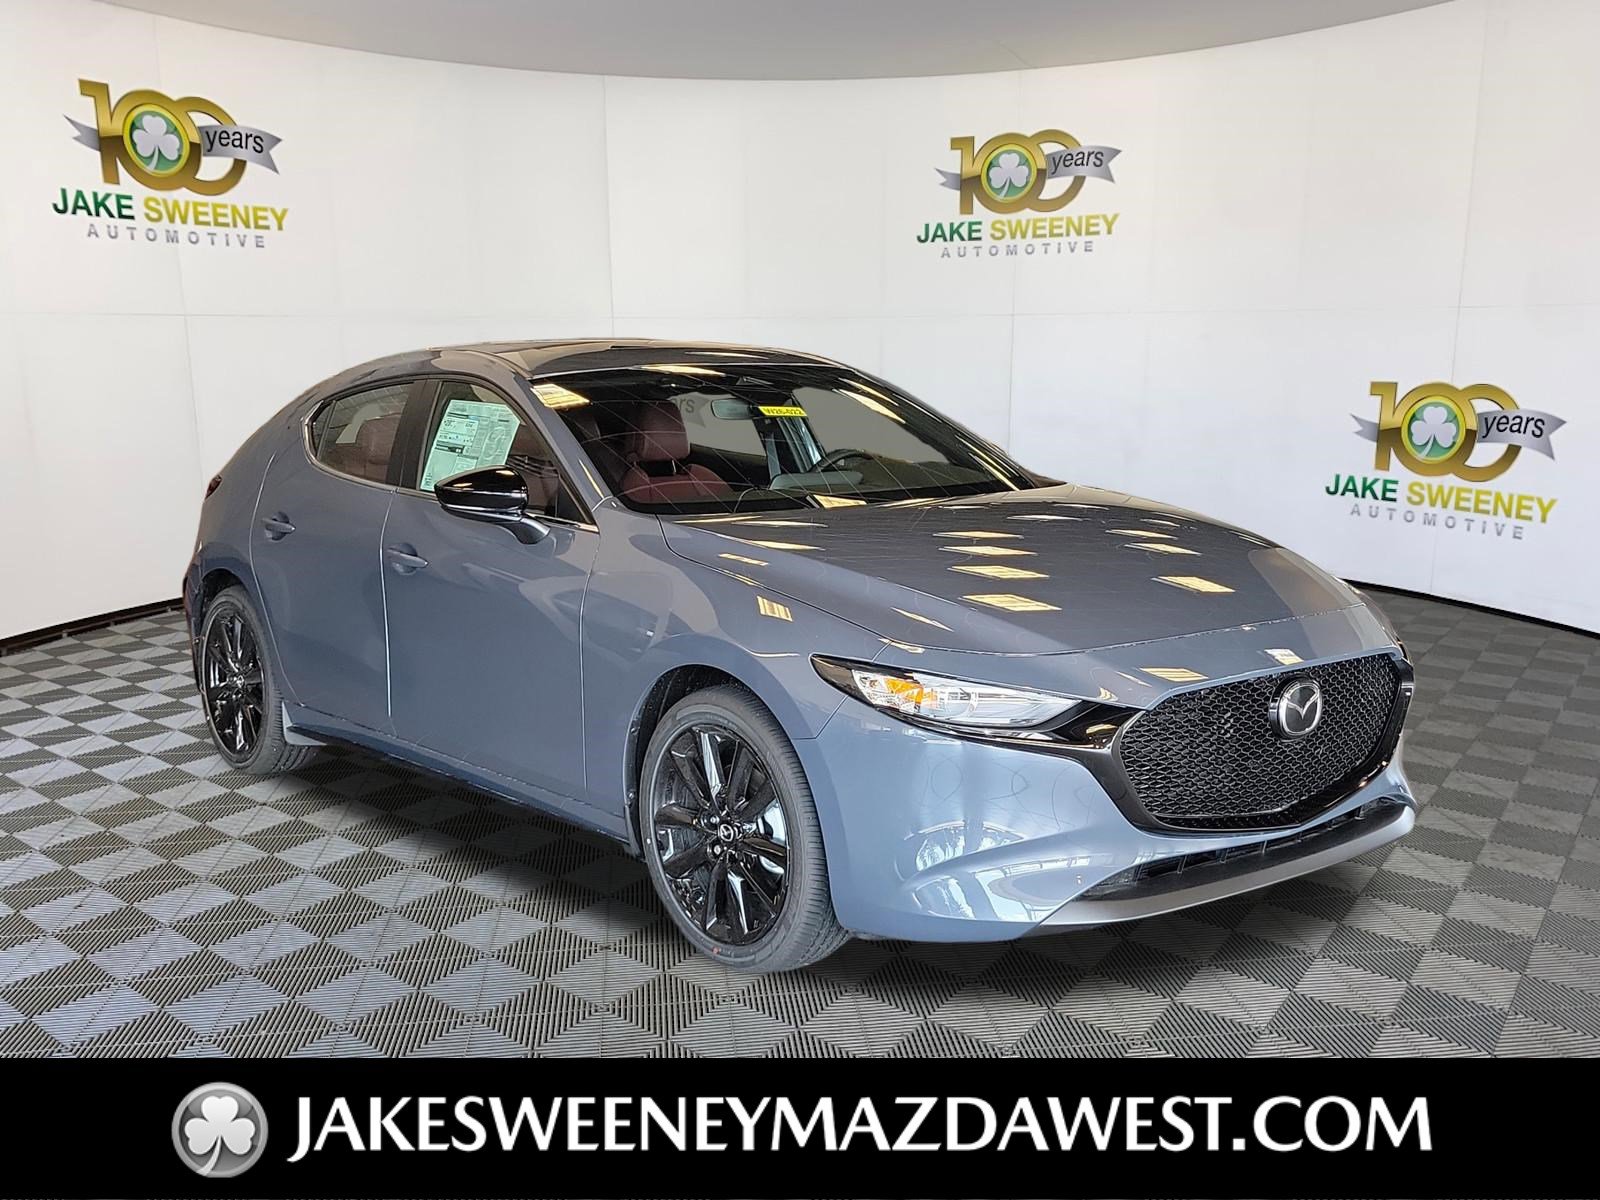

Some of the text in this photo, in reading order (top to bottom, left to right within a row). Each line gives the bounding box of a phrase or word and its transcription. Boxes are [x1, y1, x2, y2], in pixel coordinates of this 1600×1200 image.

[77, 78, 265, 196] 100 years
[950, 128, 1104, 215] 100 years
[52, 188, 289, 231] JAKE SWEENEY
[916, 213, 1120, 243] JAKE SWEENEY
[87, 223, 266, 248] AUTOMOTIVE
[940, 240, 1094, 259] AUTOMOTIVE
[1369, 381, 1545, 483] 100 years
[1325, 473, 1558, 524] JAKE SWEENEY
[1350, 503, 1524, 541] AUTOMOTIVE
